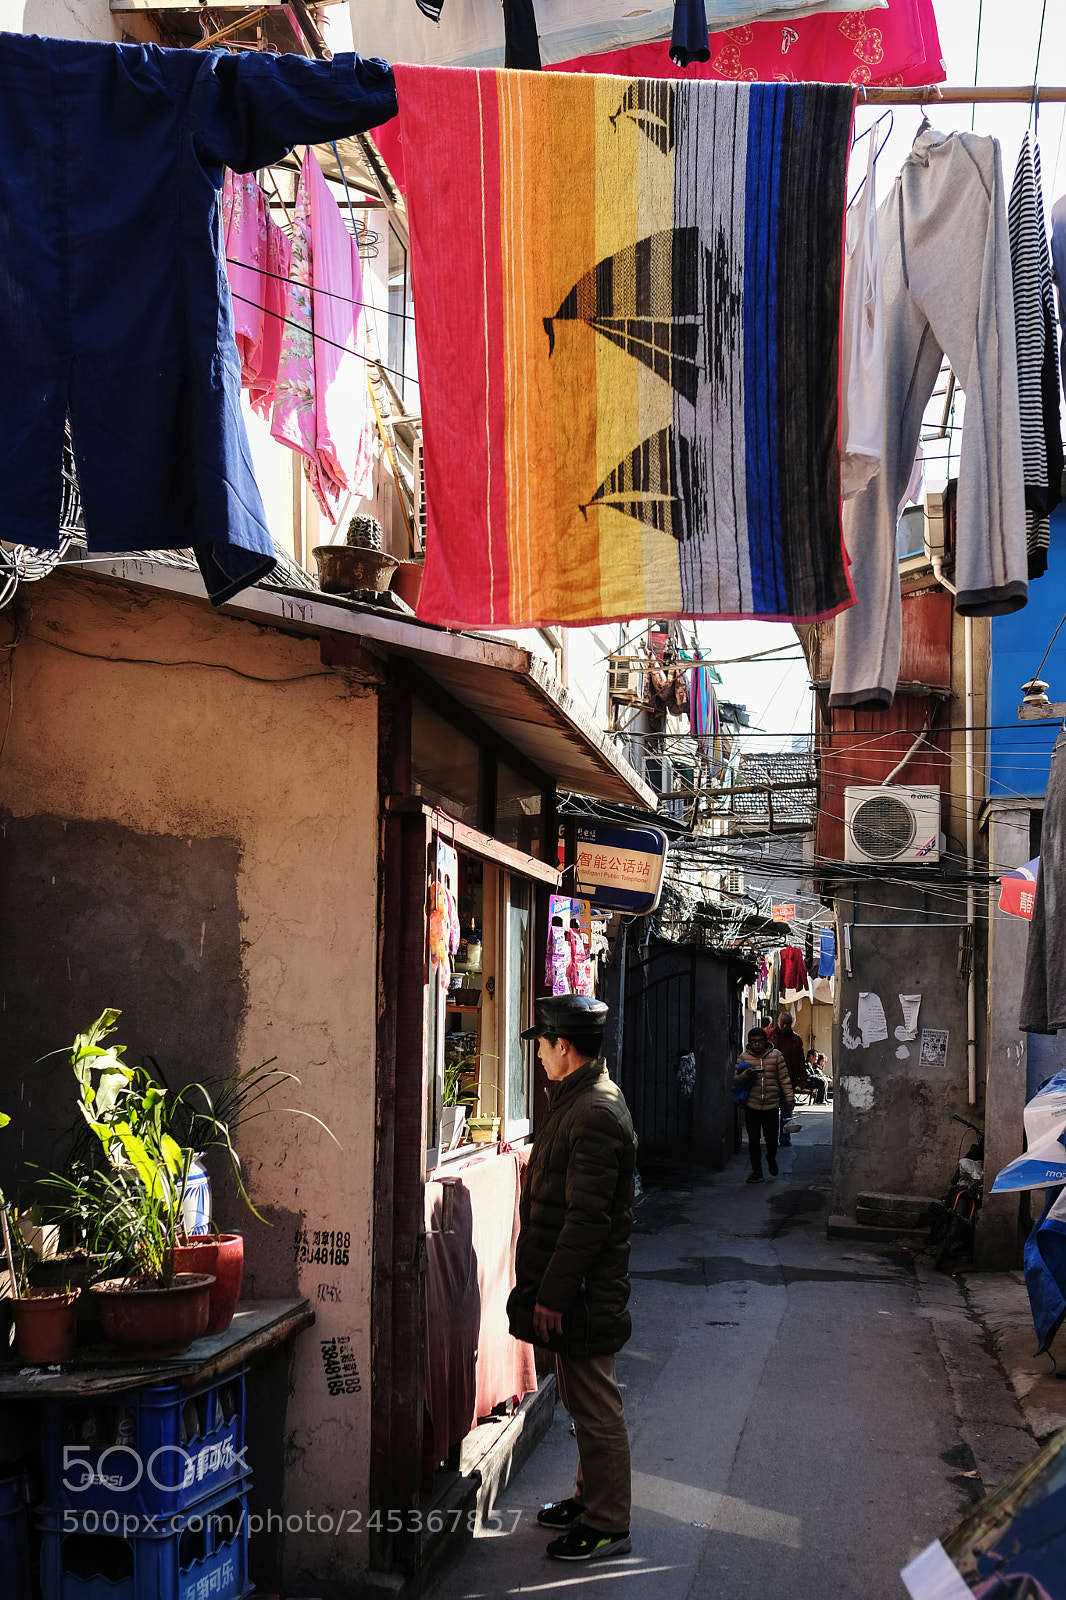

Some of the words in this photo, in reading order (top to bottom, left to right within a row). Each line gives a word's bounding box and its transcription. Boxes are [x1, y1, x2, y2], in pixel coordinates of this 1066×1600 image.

[580, 852, 651, 876] 智能公话站
[621, 874, 648, 884] Telephone
[182, 1433, 235, 1490] 百事可乐
[80, 1473, 123, 1487] PEPSI
